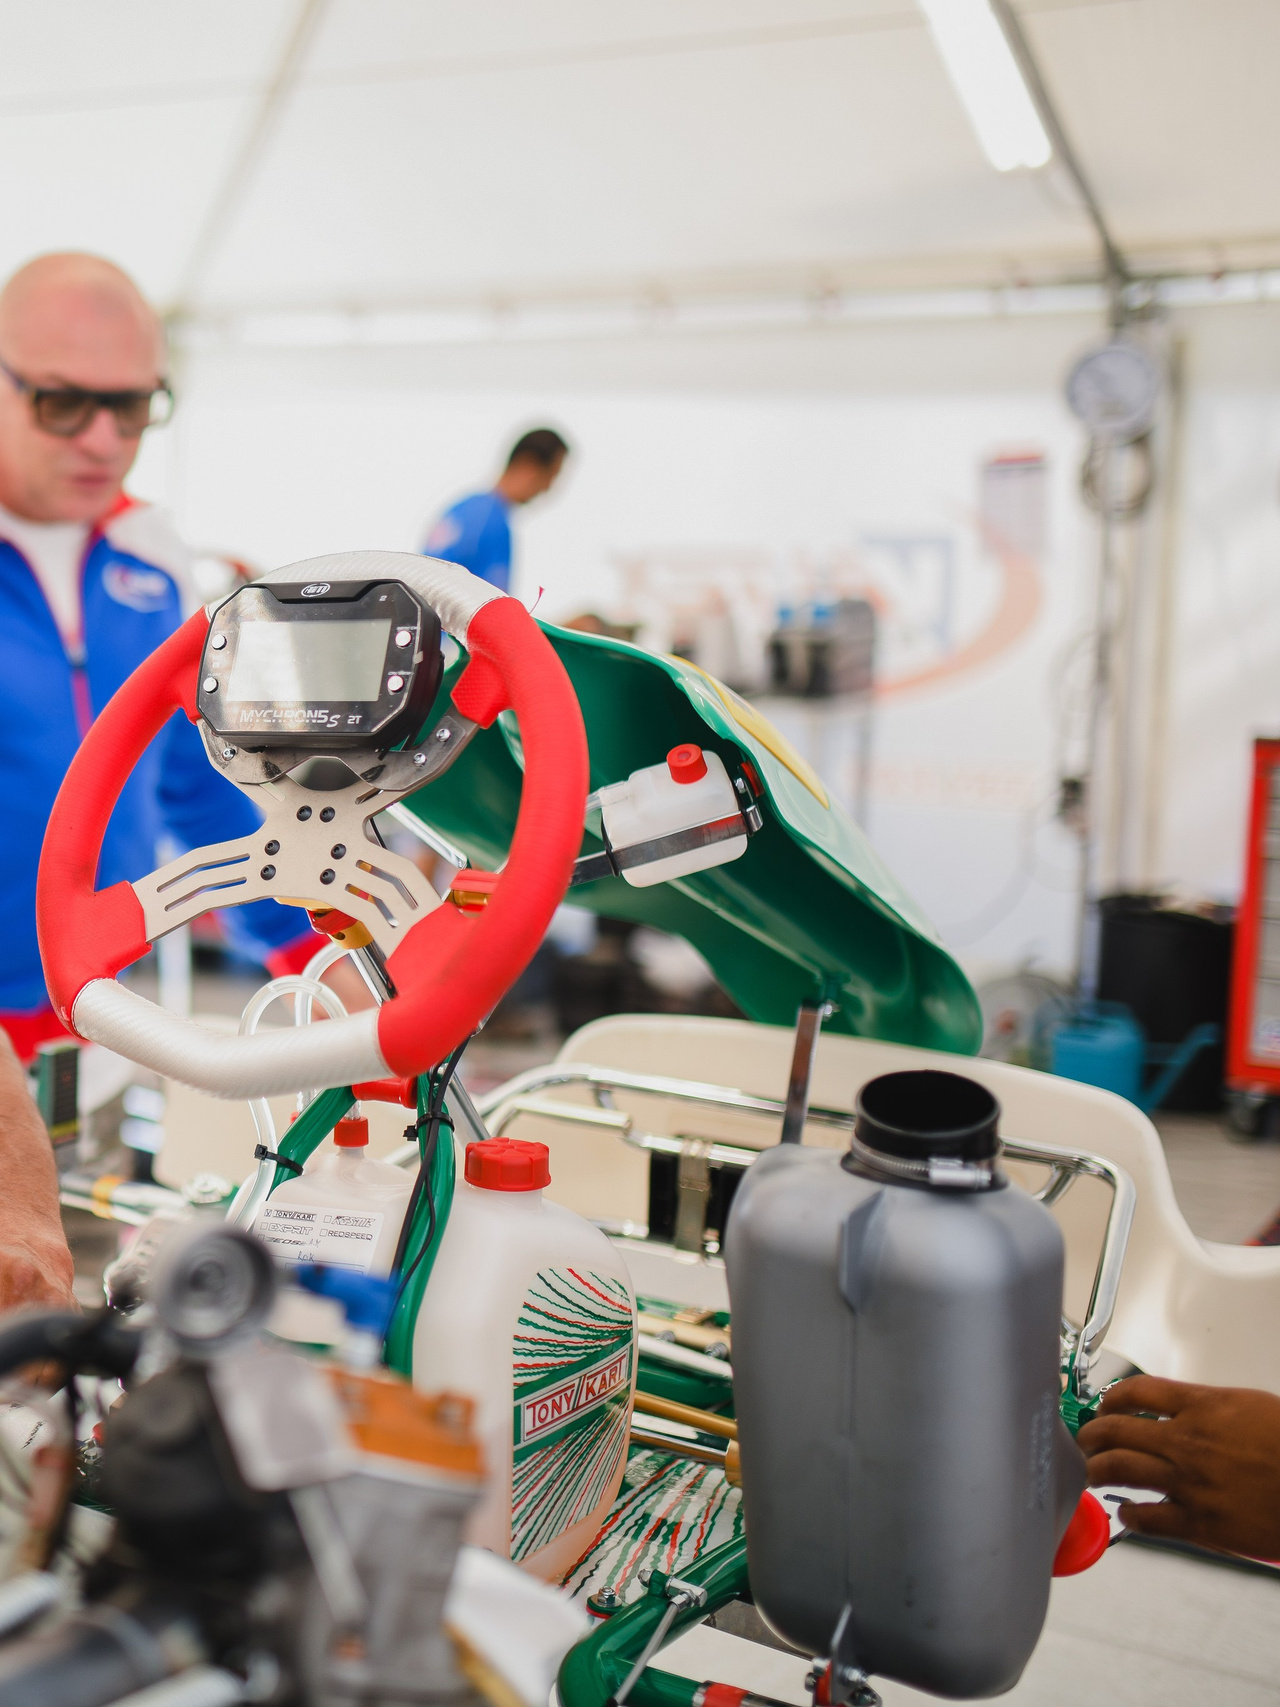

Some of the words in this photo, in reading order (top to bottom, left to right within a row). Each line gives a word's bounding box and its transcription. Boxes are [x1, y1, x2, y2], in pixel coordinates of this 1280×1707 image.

[347, 715, 363, 725] 2T
[268, 1222, 313, 1236] EXPRIT
[327, 1230, 373, 1241] REDSPEED
